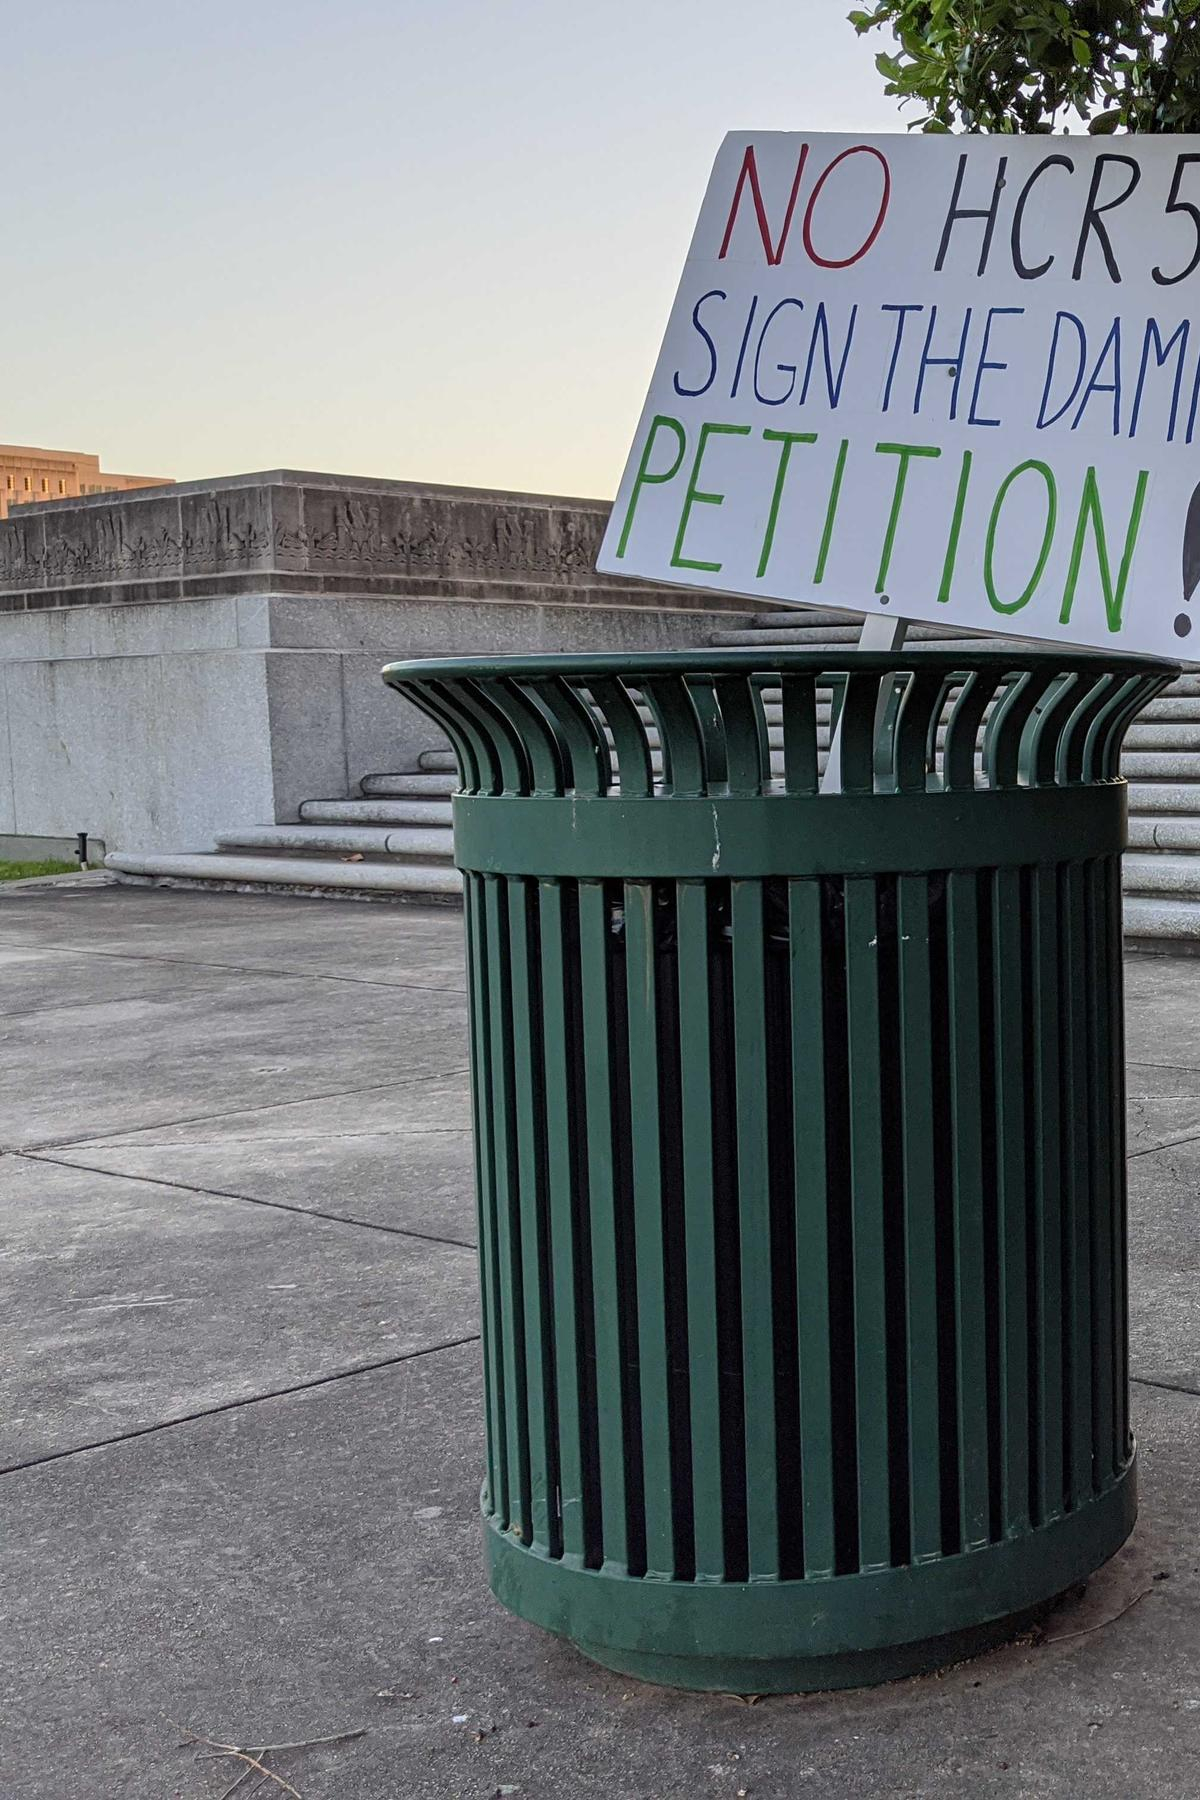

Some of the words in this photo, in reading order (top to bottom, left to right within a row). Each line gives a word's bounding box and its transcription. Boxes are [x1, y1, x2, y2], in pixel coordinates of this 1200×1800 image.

[718, 143, 891, 269] NO
[933, 153, 1141, 284] HCR
[673, 289, 858, 410] SIGN
[881, 304, 1025, 427] THE
